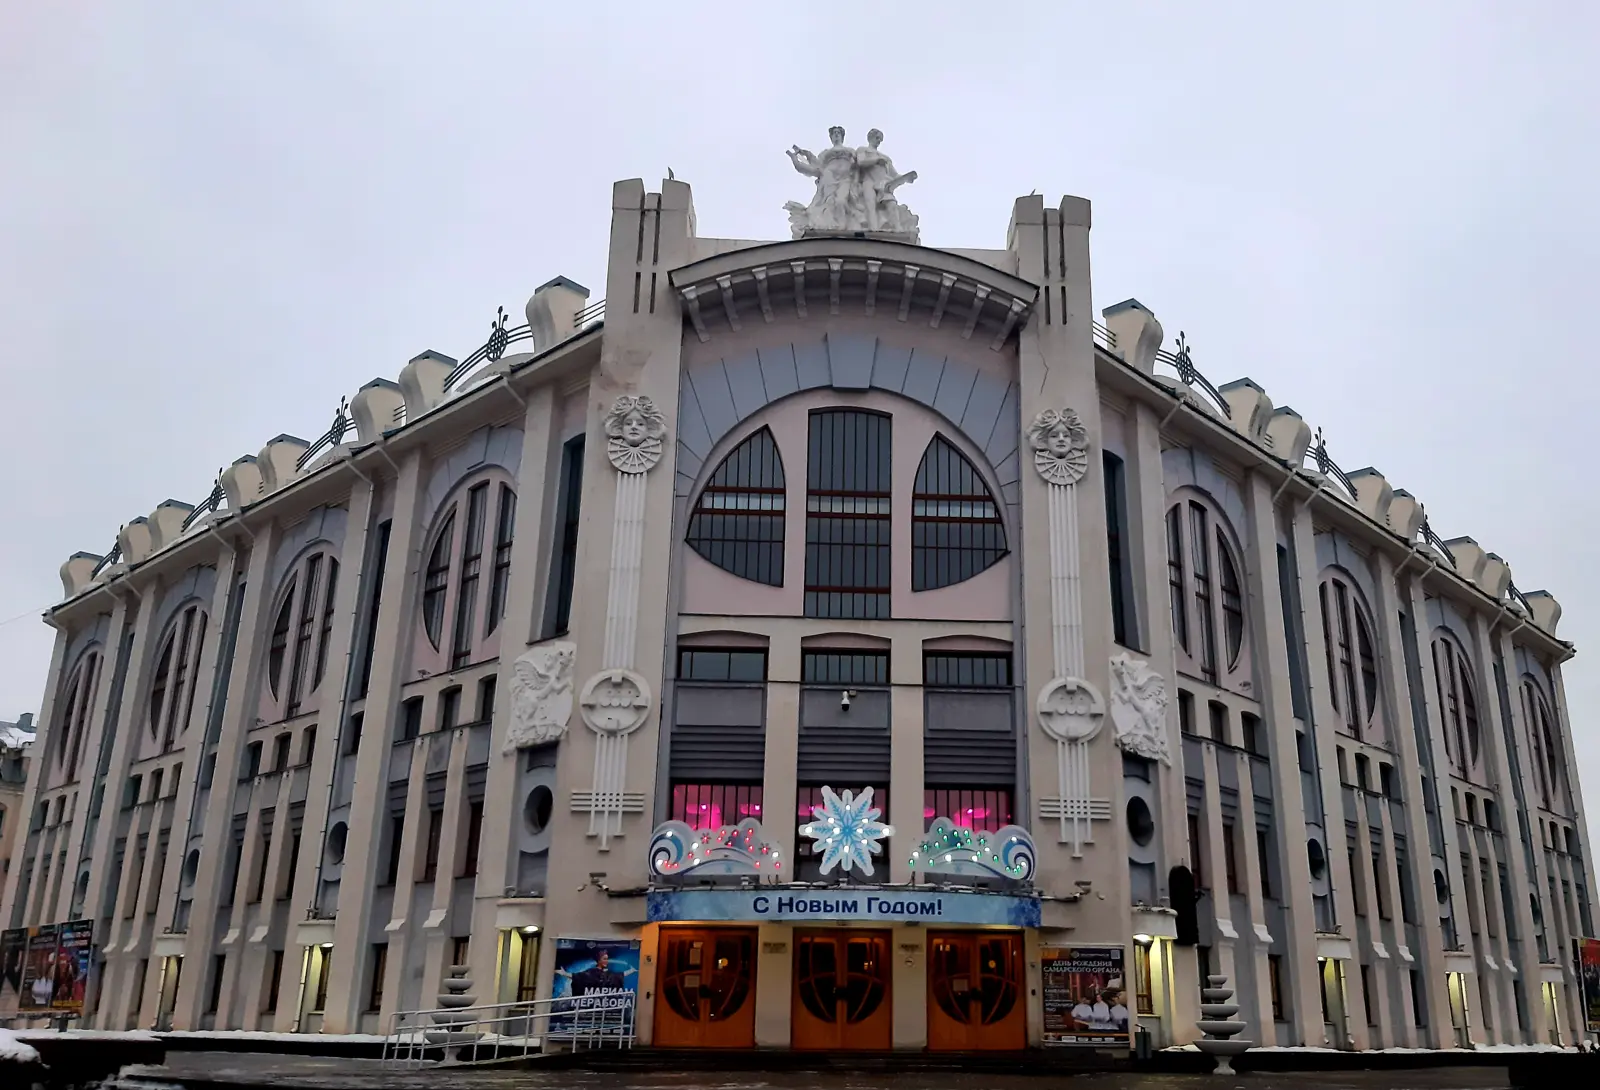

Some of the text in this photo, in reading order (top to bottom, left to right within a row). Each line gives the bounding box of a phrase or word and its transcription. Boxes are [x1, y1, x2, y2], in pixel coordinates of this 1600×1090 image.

[753, 896, 943, 915] С Новым Годом!
[571, 998, 631, 1007] МЕРАБОВА
